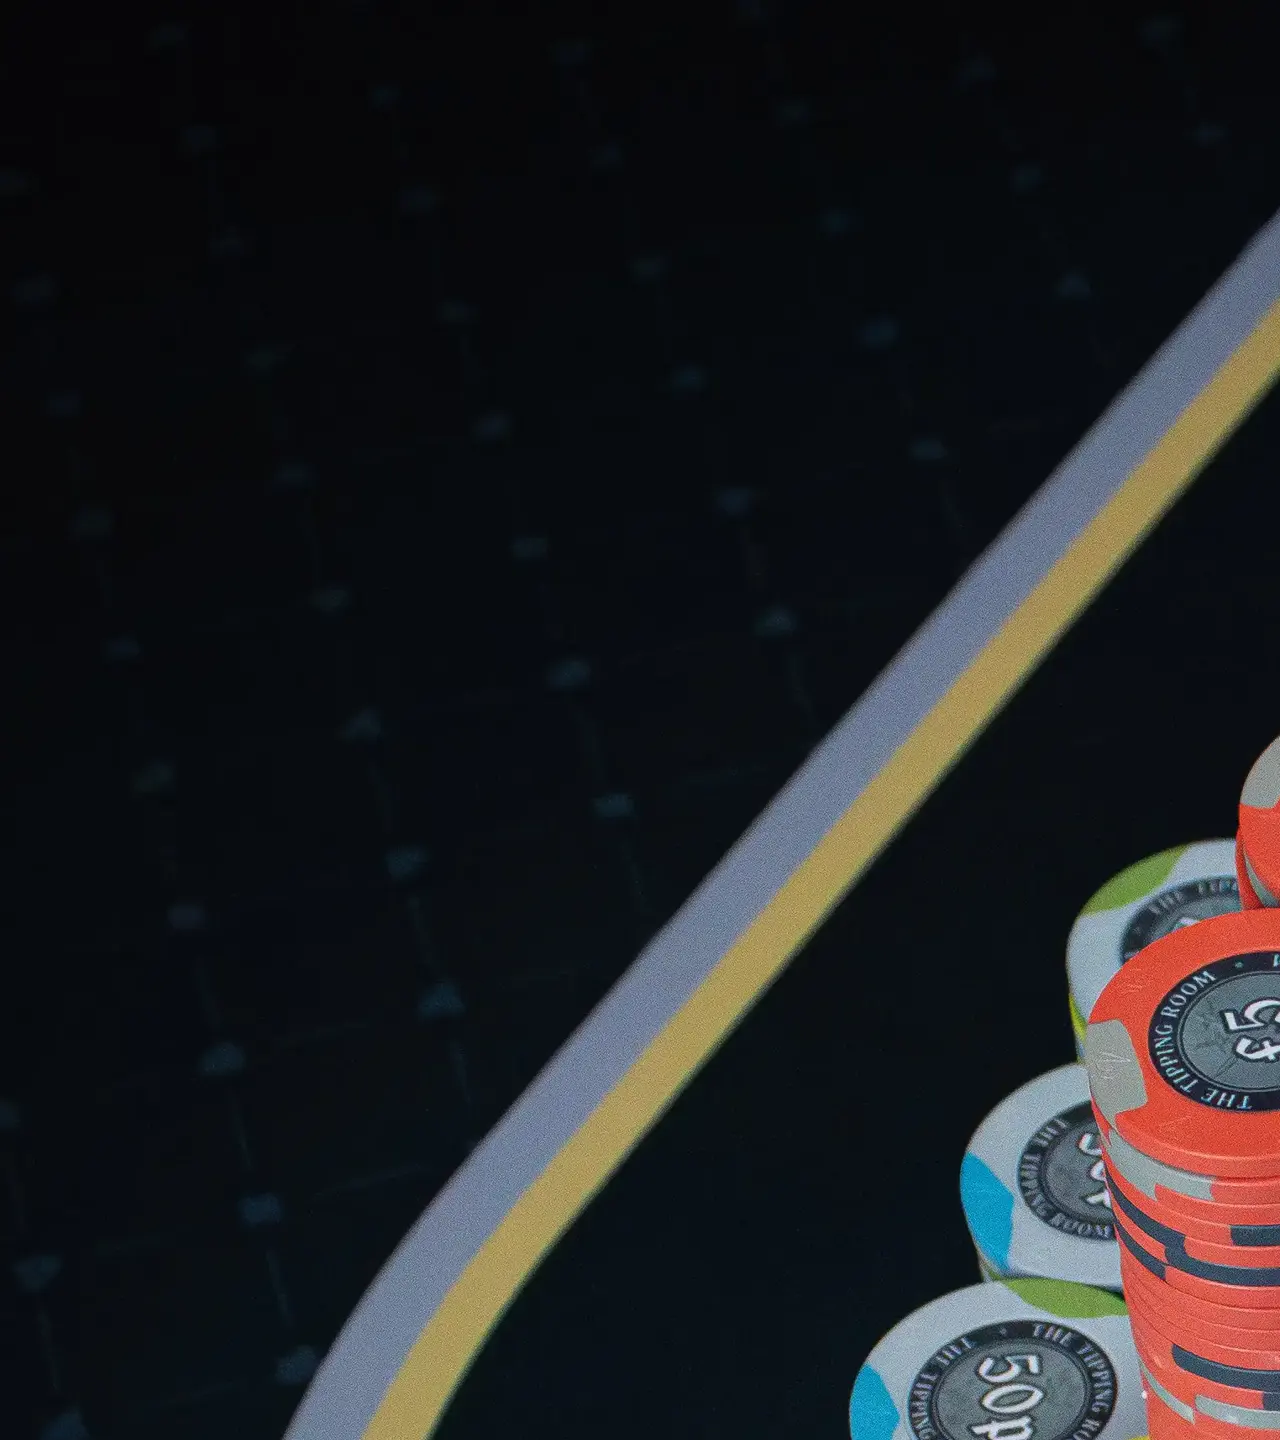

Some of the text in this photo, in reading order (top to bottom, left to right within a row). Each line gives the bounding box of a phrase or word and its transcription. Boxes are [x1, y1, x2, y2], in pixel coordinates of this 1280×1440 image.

[1159, 970, 1216, 1020] ROOM
[1154, 1025, 1199, 1093] TIPPING
[1201, 1088, 1251, 1109] THE
